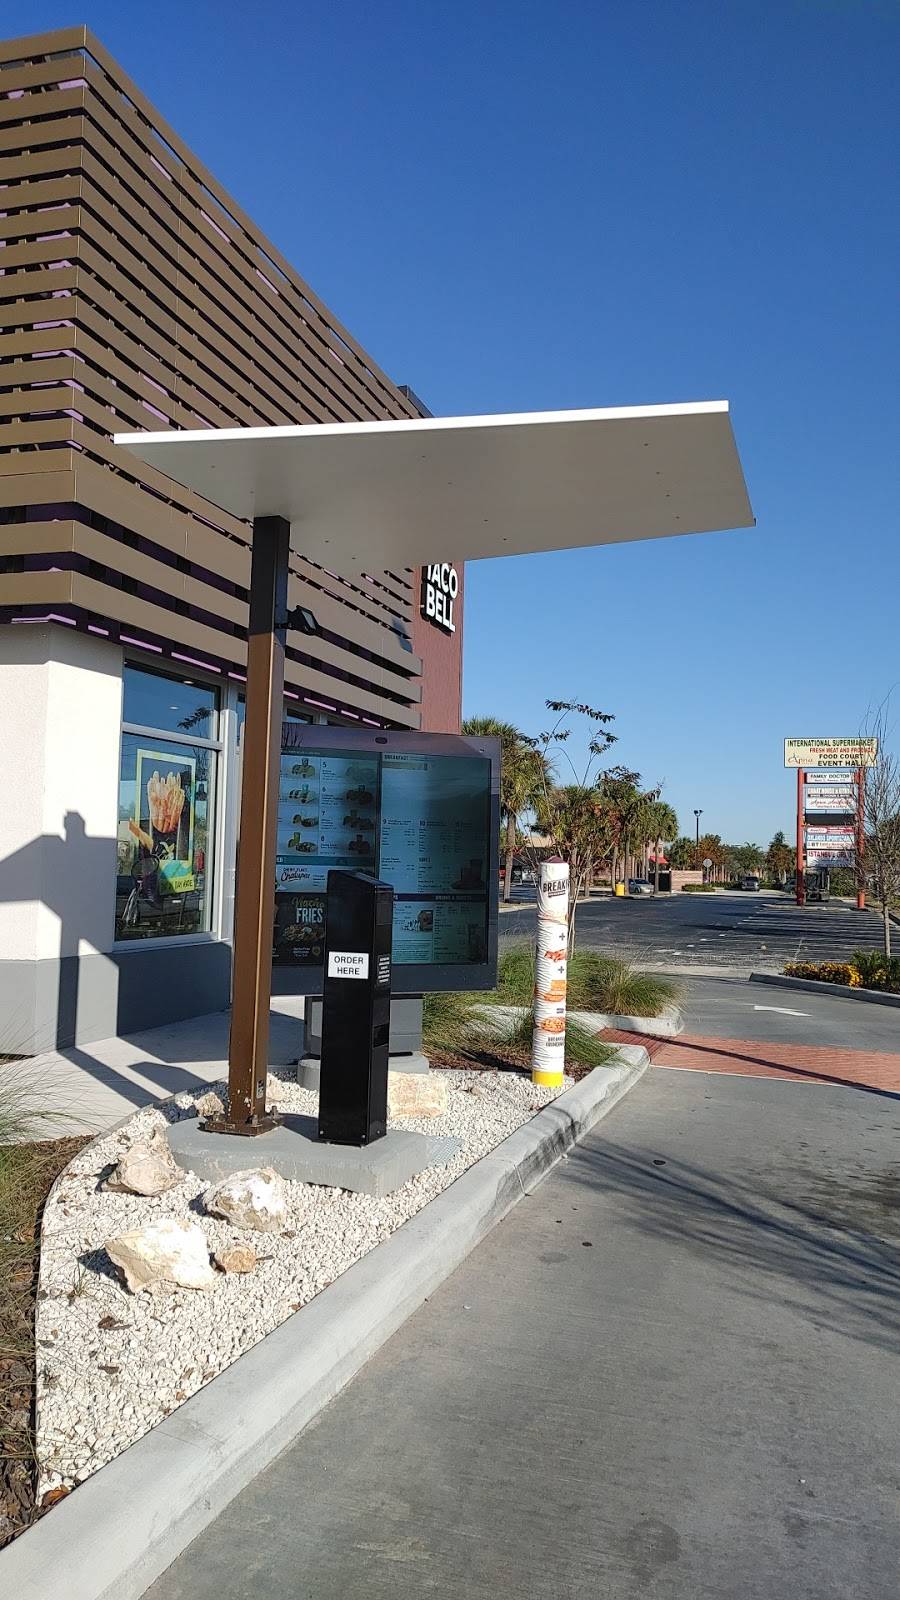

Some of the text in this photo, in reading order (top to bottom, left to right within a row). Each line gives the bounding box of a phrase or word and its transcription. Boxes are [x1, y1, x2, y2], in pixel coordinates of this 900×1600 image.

[426, 583, 456, 632] BELL
[787, 739, 831, 747] INTERNATIONAL
[296, 907, 323, 923] FRIES
[333, 955, 364, 965] ORDER
[336, 966, 361, 976] HERE
